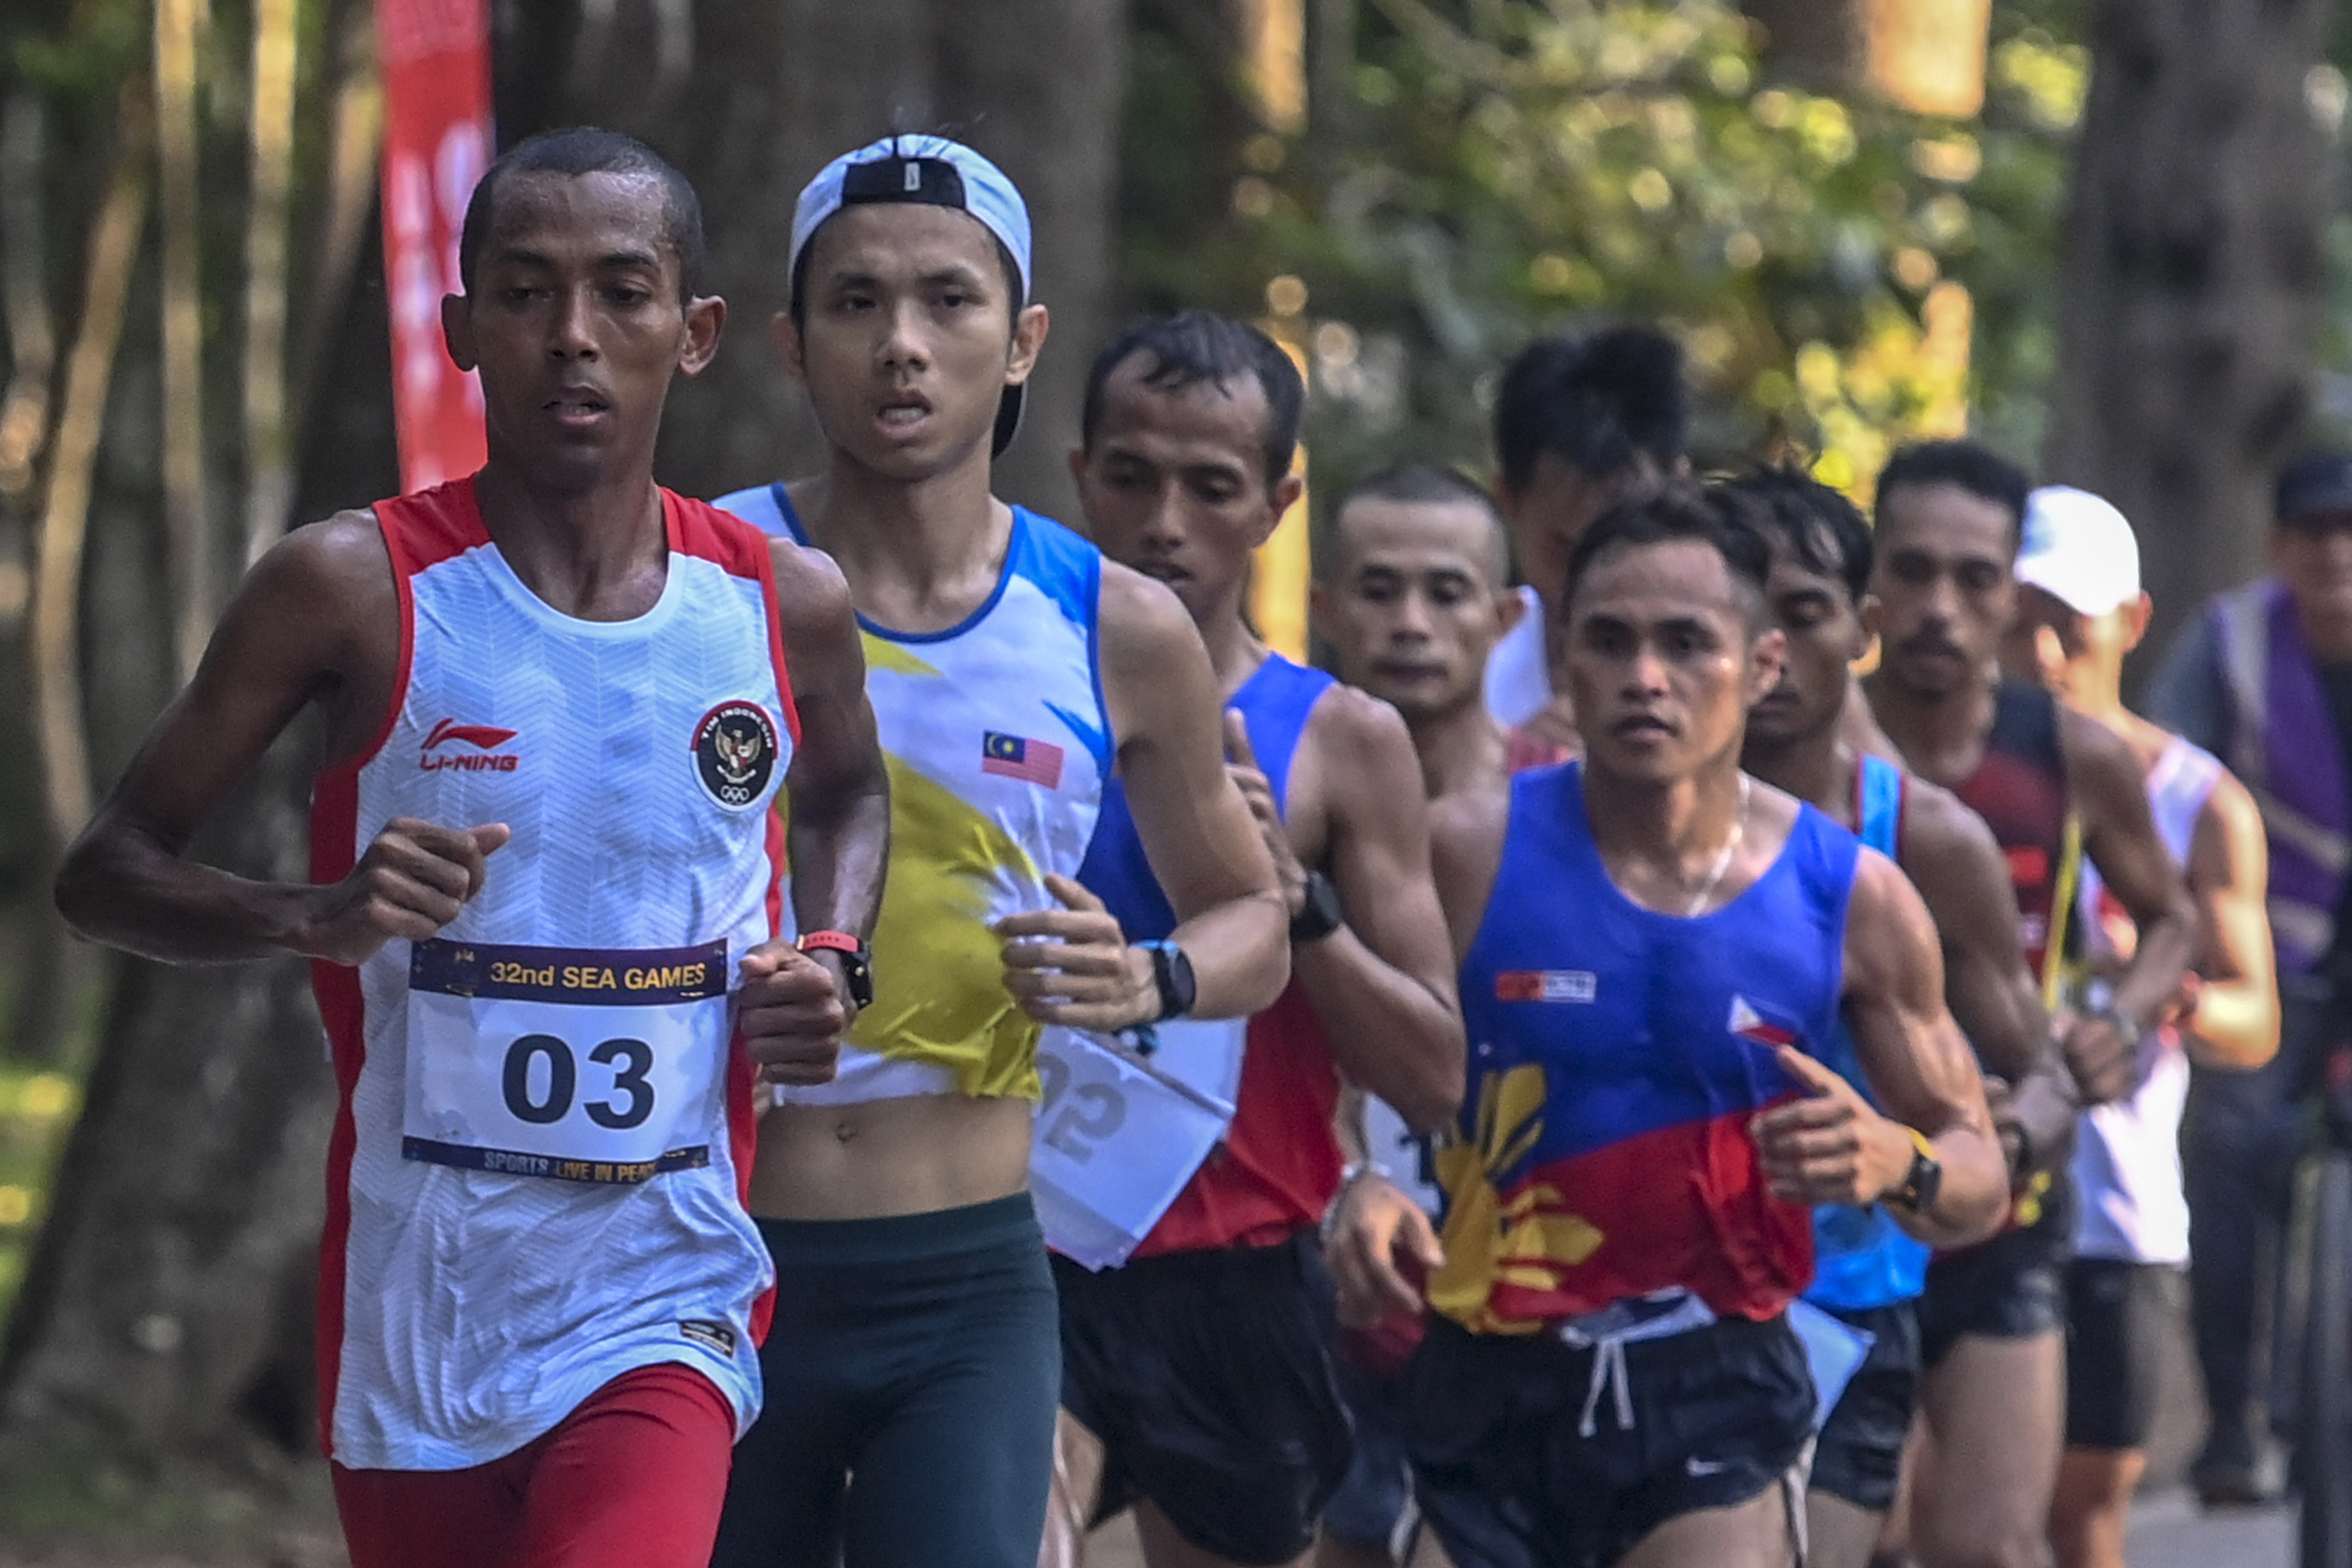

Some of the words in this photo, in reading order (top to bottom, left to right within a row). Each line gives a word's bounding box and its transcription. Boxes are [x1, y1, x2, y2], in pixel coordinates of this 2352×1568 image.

[420, 755, 519, 771] LI-NING
[490, 963, 555, 986] 32nd
[562, 966, 617, 989] SEA
[624, 963, 706, 990] GAMES
[504, 1034, 655, 1130] 03
[484, 1151, 548, 1172] SPORTS
[595, 1164, 612, 1181] IN
